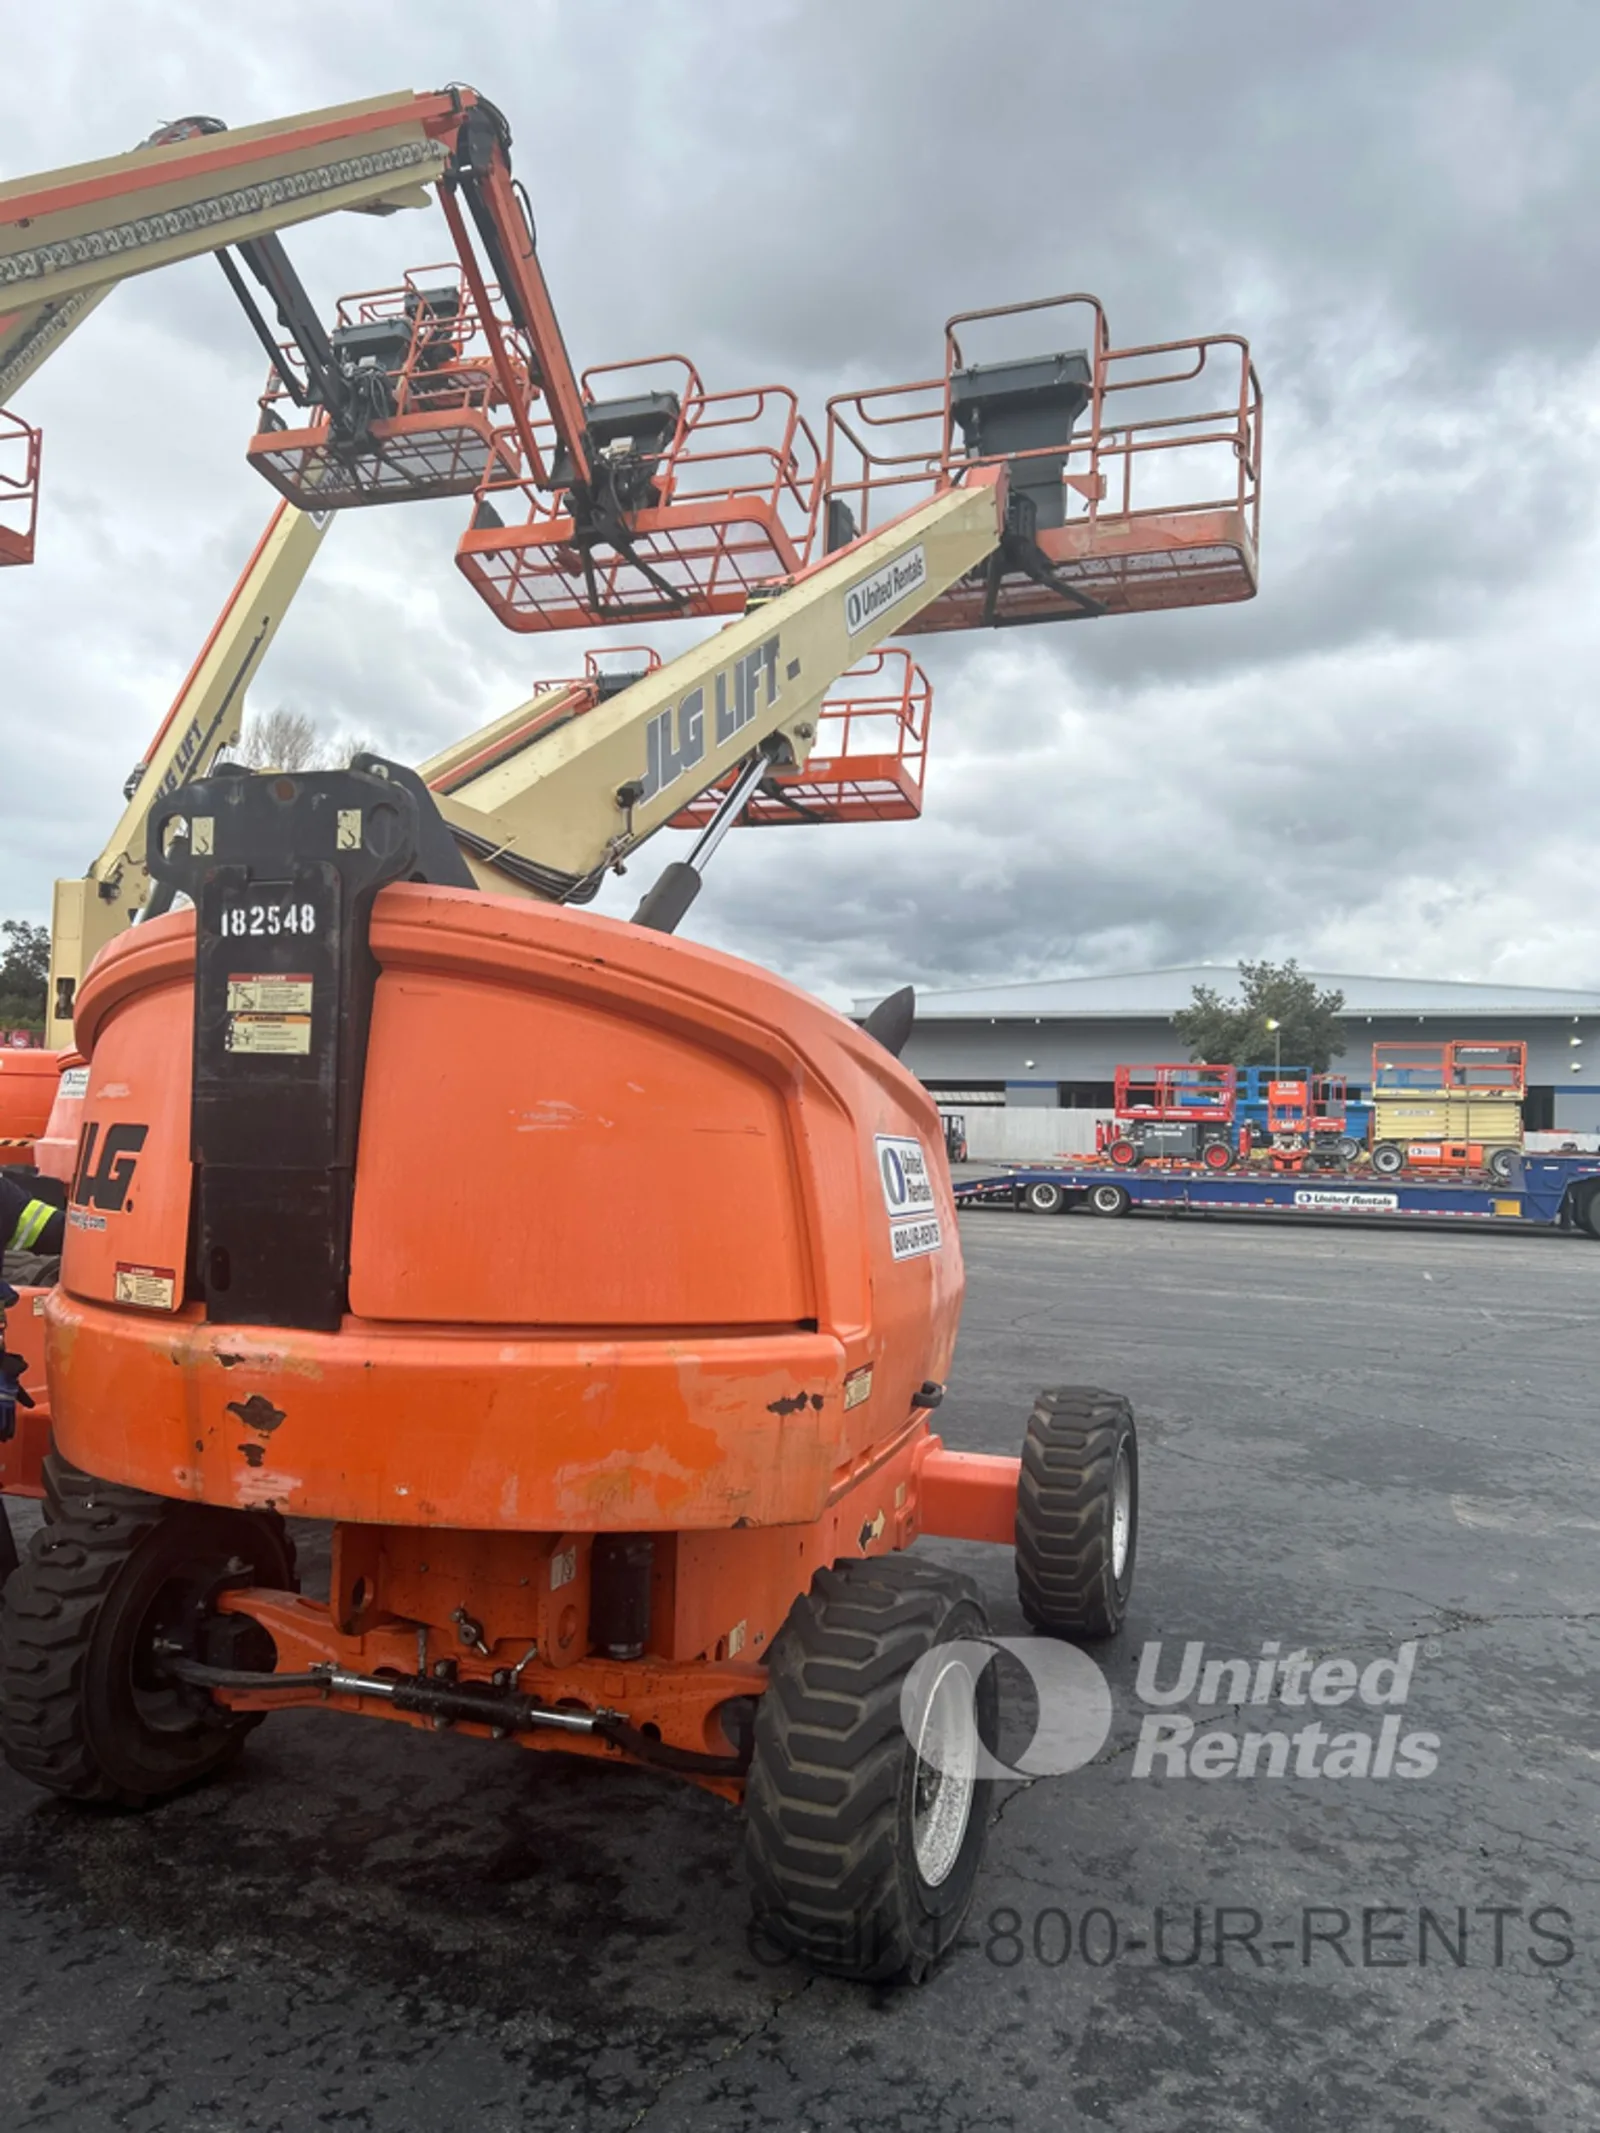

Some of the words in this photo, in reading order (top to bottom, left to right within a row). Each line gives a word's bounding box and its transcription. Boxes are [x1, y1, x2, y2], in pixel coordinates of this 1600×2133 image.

[861, 571, 893, 616] United
[893, 553, 924, 593] Rentals
[637, 685, 705, 808] JLG
[715, 634, 781, 748] LIFT
[221, 903, 316, 937] 182548
[900, 1149, 924, 1175] United
[906, 1177, 933, 1204] Rentals
[1314, 1193, 1351, 1204] United
[1351, 1195, 1393, 1206] Rentals
